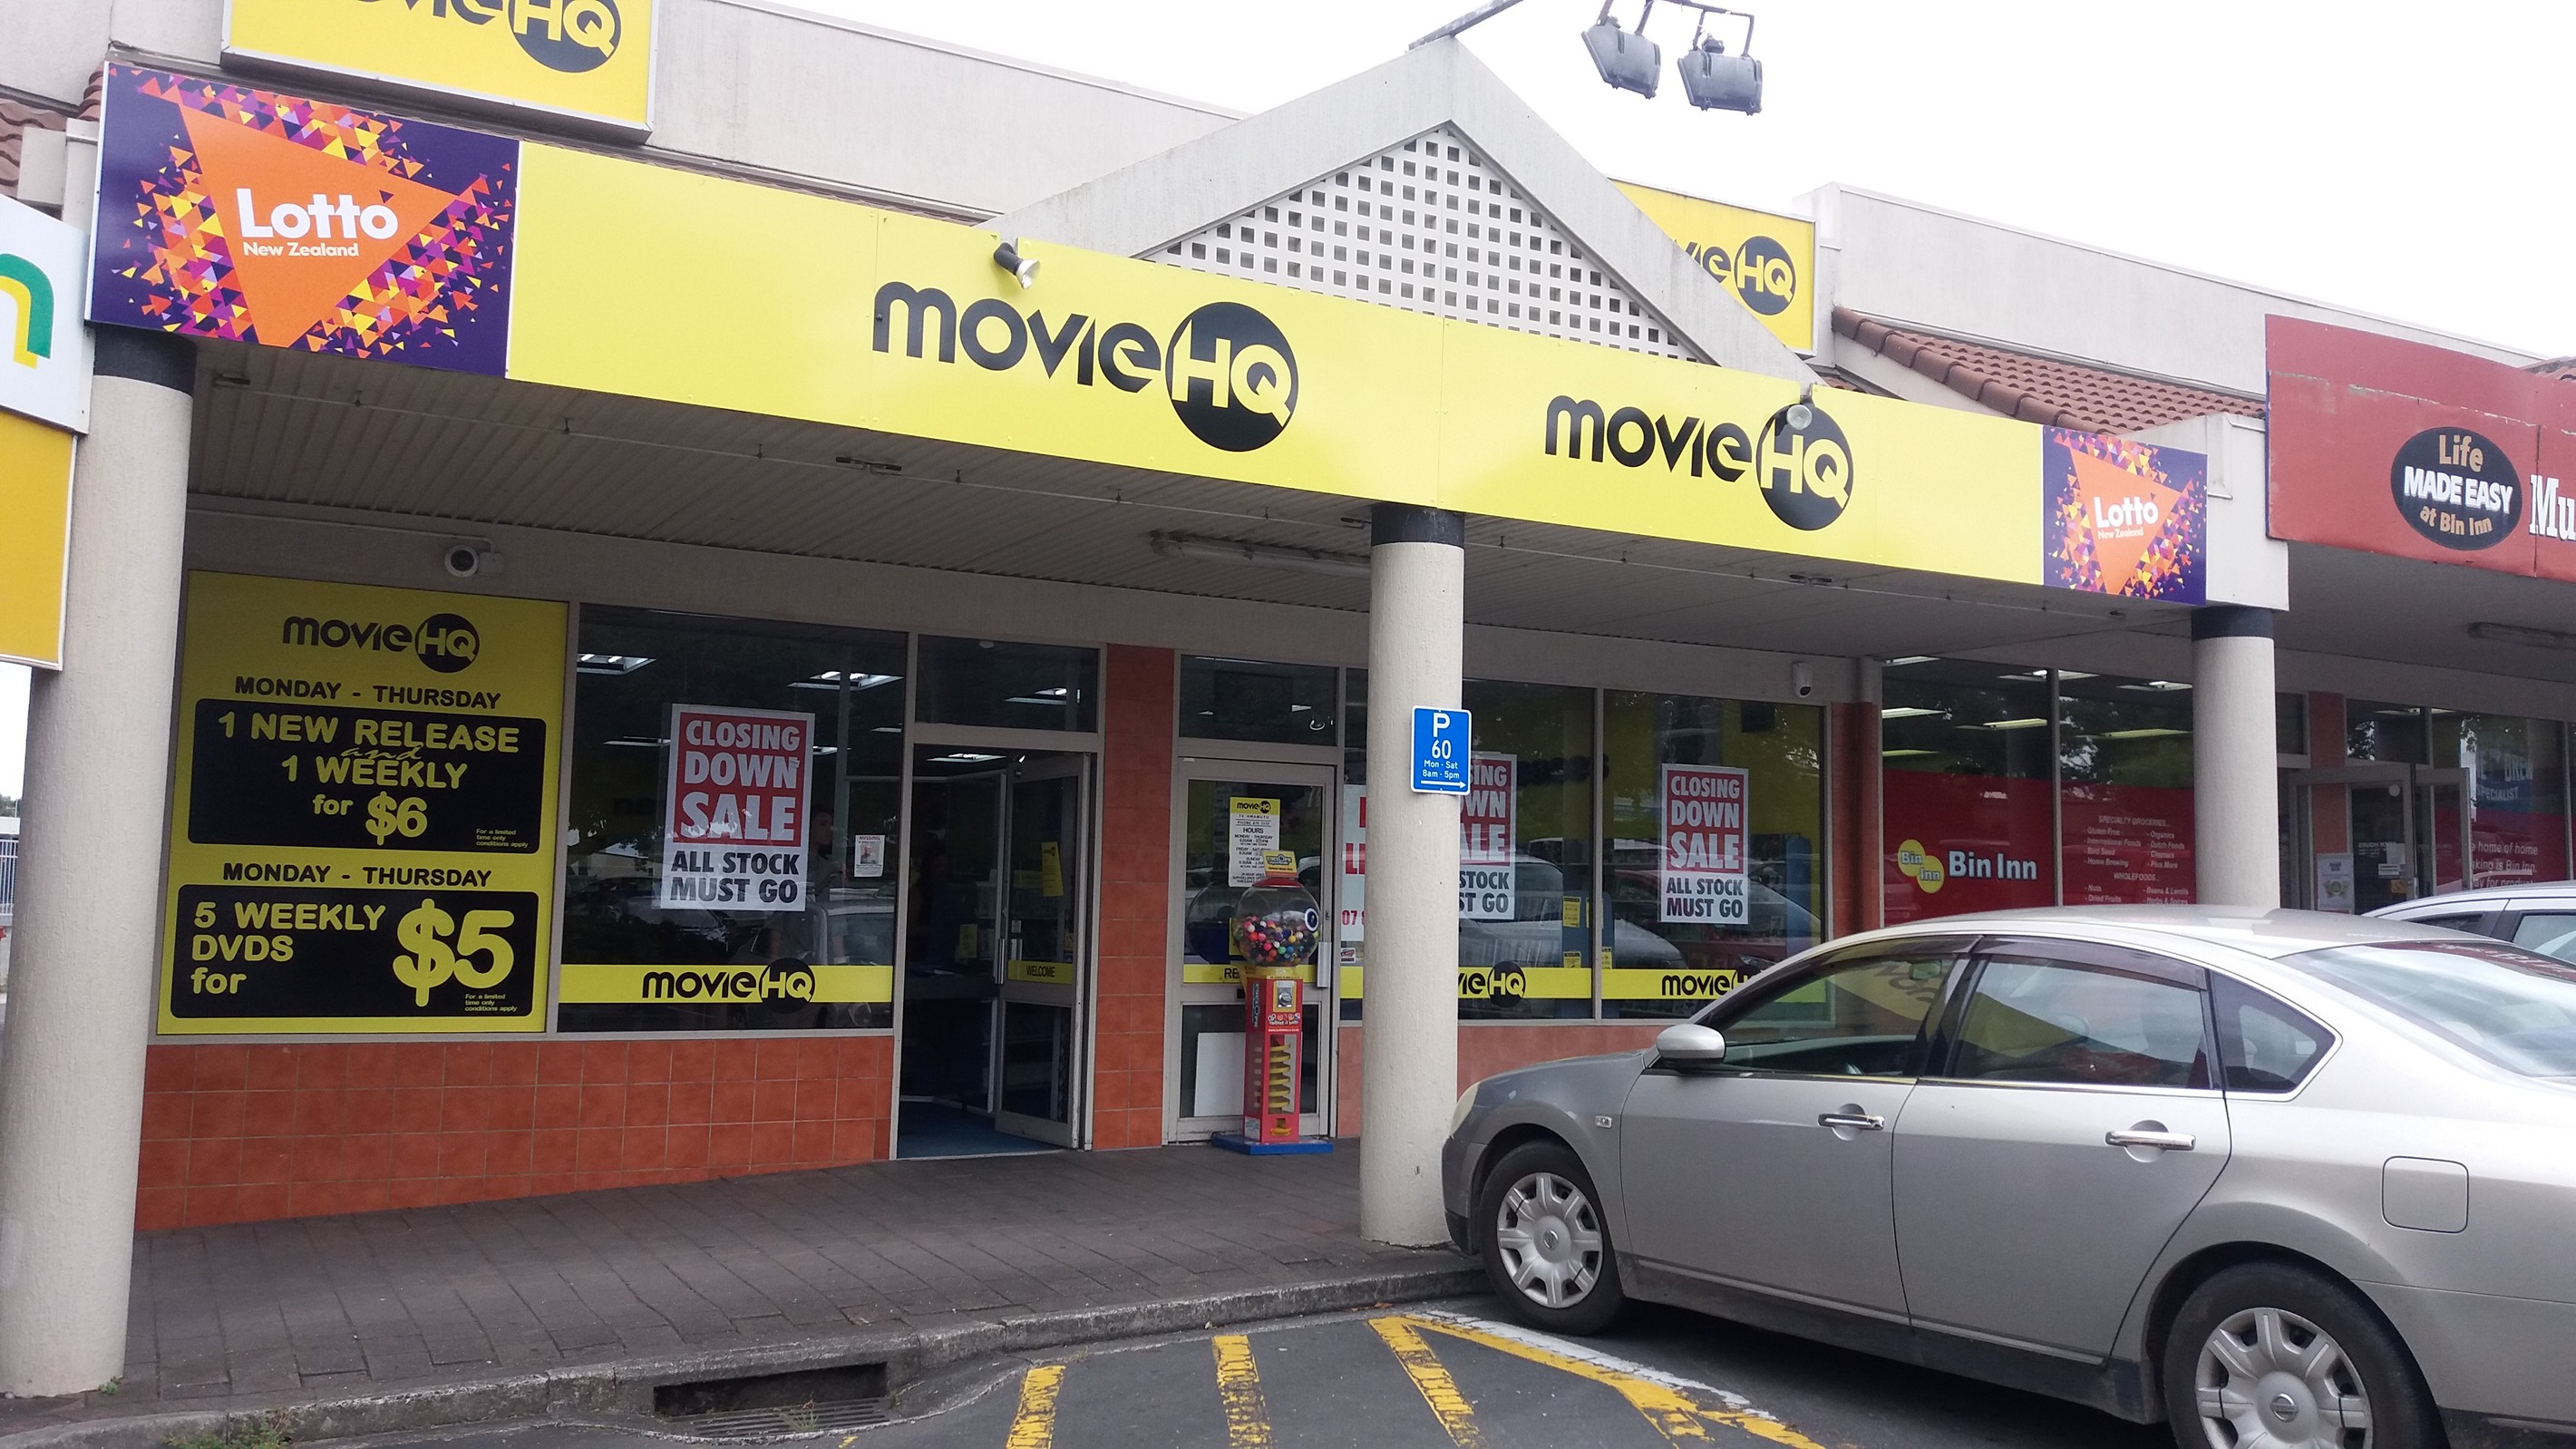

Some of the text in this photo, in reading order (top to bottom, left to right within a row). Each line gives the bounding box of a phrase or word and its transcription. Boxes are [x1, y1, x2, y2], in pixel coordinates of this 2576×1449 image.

[235, 188, 399, 239] Lotto
[243, 241, 360, 258] New Zealand
[2438, 433, 2484, 473] Life
[2404, 466, 2513, 515] MADE EASY
[2093, 496, 2159, 529] Lotto
[2419, 504, 2493, 537] at Bin Inn
[2097, 529, 2144, 540] New Zealand
[234, 676, 342, 700] MONDAY
[373, 685, 502, 710] THURSDAY
[219, 712, 520, 754] 1 NEW RELEASE
[685, 719, 802, 752] CLOSING
[1433, 712, 1451, 738] P
[340, 744, 423, 761] and
[1431, 740, 1452, 760] 60
[281, 755, 468, 790] 1 WEEKLY
[684, 750, 800, 789] DOWN
[1422, 769, 1439, 778] 8am
[1444, 770, 1460, 780] 5pm
[1424, 759, 1441, 769] Mon
[1445, 760, 1459, 770] Sat
[1670, 775, 1740, 800] CLOSING
[312, 791, 428, 846] for $6
[679, 792, 795, 841] SALE
[1670, 799, 1740, 829] DOWN
[2098, 815, 2131, 824] SPECIALTY
[1670, 831, 1740, 870] SALE
[2124, 839, 2142, 847] Foods
[2478, 840, 2503, 853] home
[2503, 841, 2514, 854] of
[2514, 842, 2539, 856] home
[670, 850, 800, 876] ALL STOCK
[1900, 850, 1923, 865] Bin
[1948, 850, 2039, 881] Bin Inn
[2086, 857, 2105, 865] Home
[2495, 859, 2503, 871] is
[2505, 859, 2521, 871] Bin
[222, 862, 332, 884] MONDAY
[362, 866, 492, 888] THURSDAY
[1459, 870, 1510, 890] STOCK
[1666, 877, 1744, 897] ALL STOCK
[1920, 867, 1941, 881] Inn
[2486, 876, 2498, 888] for
[668, 876, 798, 904] MUST GO
[1482, 892, 1509, 913] GO
[194, 901, 387, 931] 5 WEEKLY
[1341, 909, 1358, 926] 07
[1666, 897, 1744, 919] MUST GO
[190, 934, 295, 962] DVDS
[392, 898, 516, 1007] $5
[190, 967, 247, 996] for
[1026, 965, 1055, 978] WELCOME
